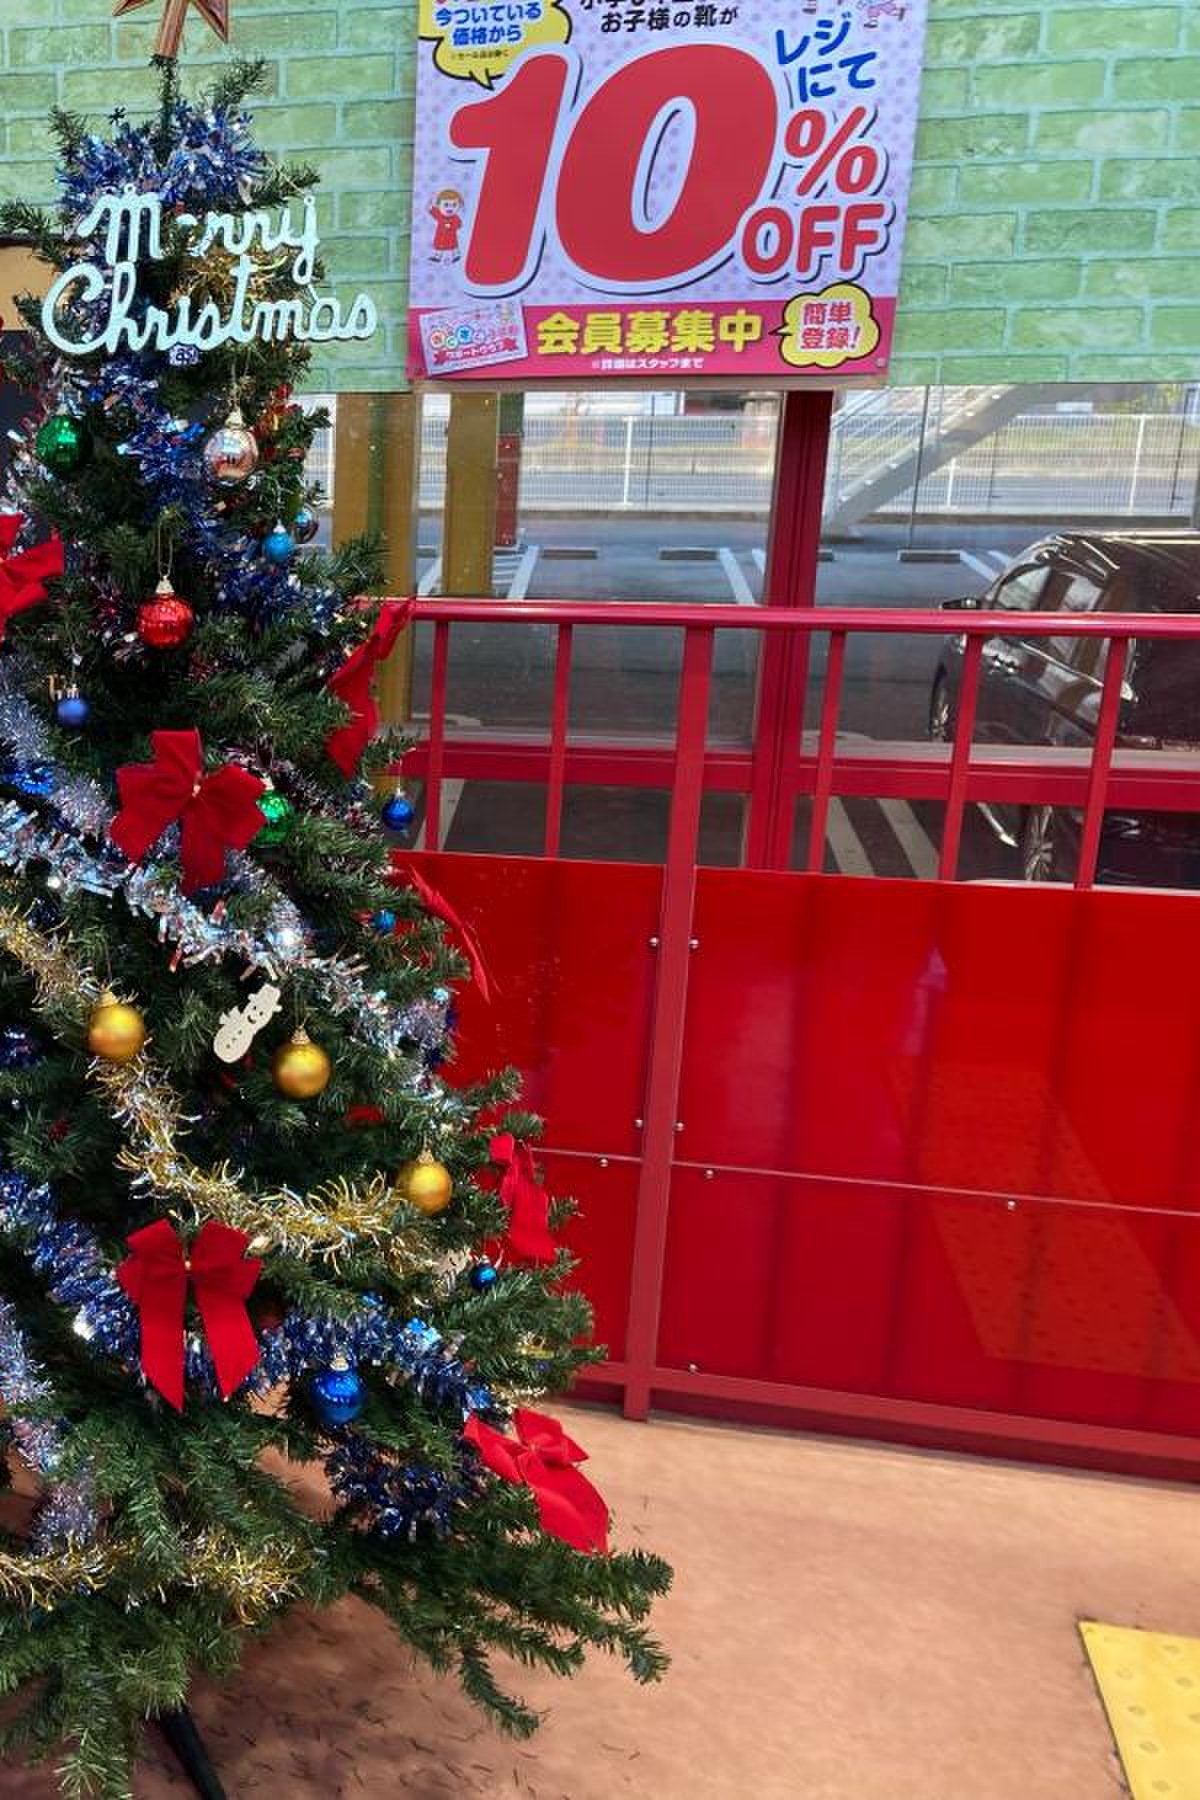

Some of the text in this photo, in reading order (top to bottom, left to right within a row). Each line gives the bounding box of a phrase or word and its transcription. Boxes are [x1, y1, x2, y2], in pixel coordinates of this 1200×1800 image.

[435, 2, 542, 27] 今ついている
[453, 25, 522, 46] 価格から
[601, 4, 738, 33] お子様の靴が
[775, 11, 852, 65] レジ
[798, 51, 877, 103] にて
[449, 44, 778, 286] 10
[742, 204, 884, 275] OFF
[41, 256, 377, 354] Christmas
[802, 302, 852, 325] 簡単
[537, 310, 763, 354] 会員募集中
